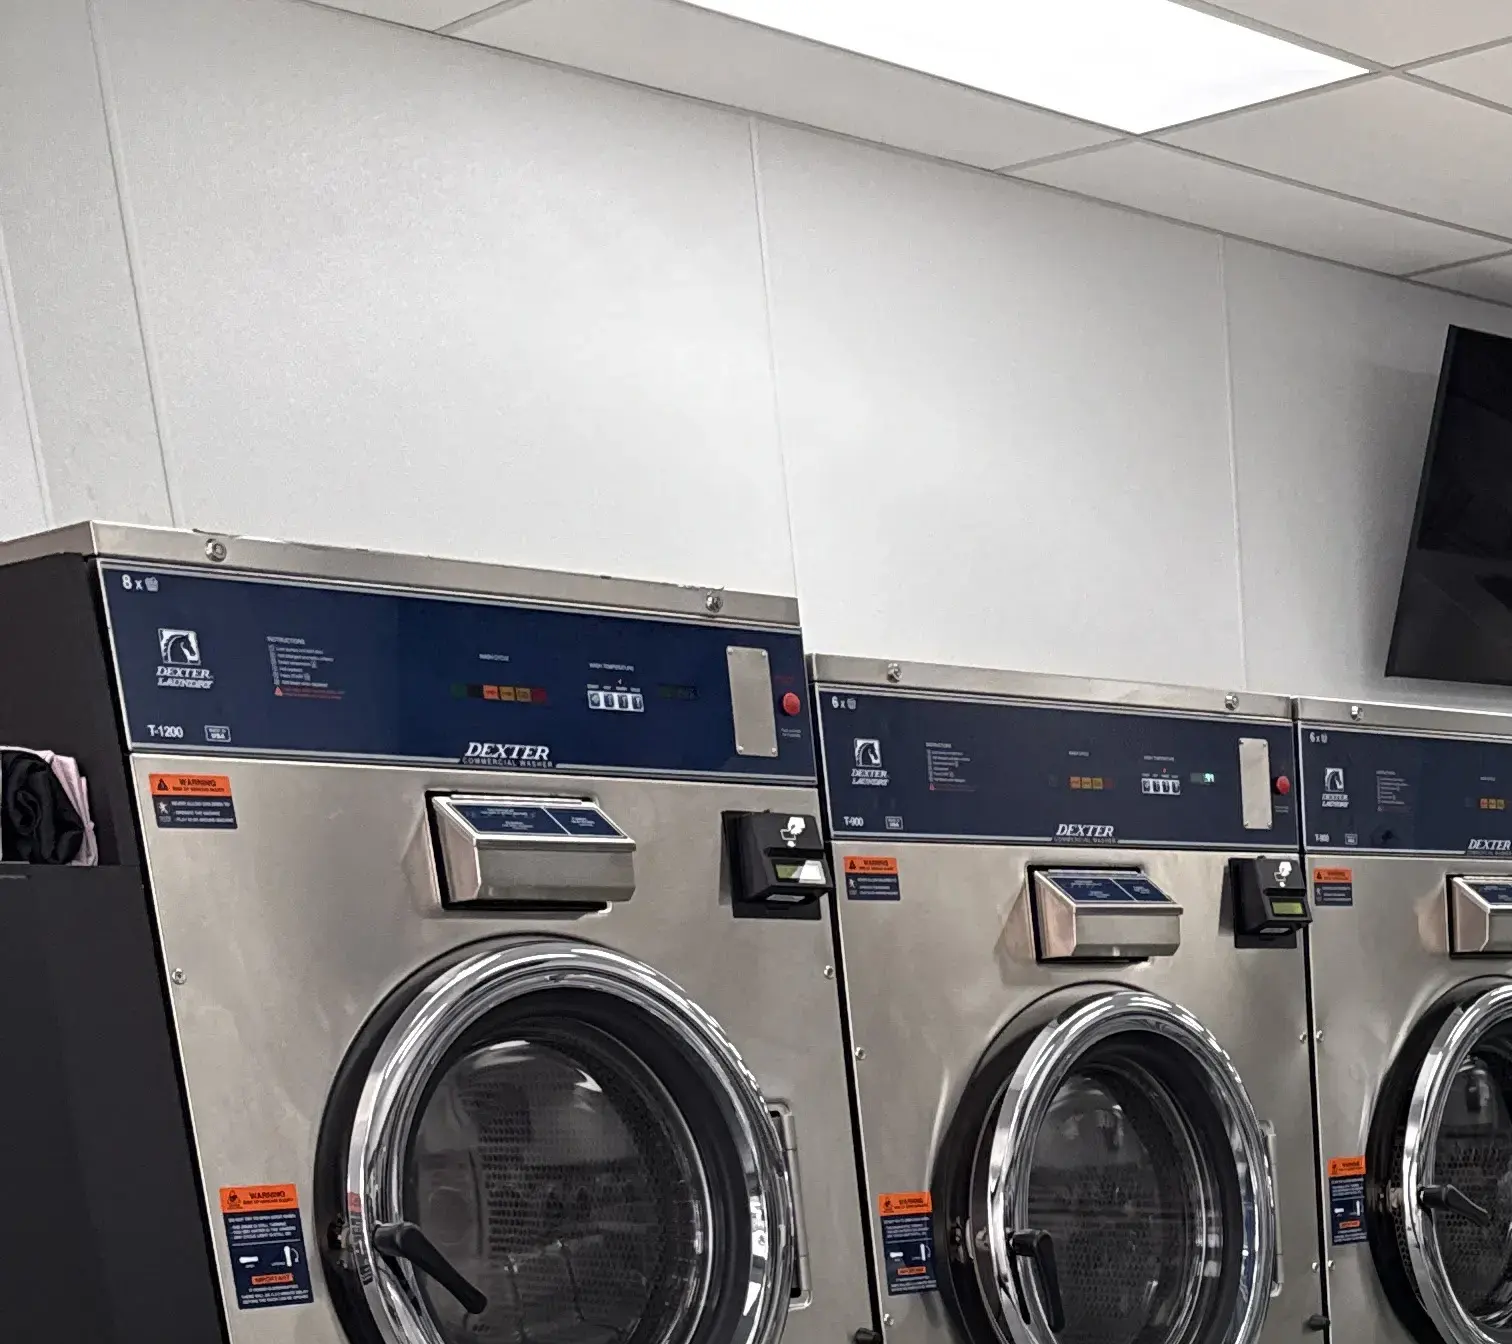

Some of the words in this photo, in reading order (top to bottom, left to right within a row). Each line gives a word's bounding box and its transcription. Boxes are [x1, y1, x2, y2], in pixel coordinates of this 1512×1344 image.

[121, 574, 133, 590] 8
[156, 666, 211, 679] DEXTER
[157, 678, 213, 689] LAUNDRY
[147, 724, 184, 738] T-1200
[464, 741, 550, 760] DEXTER
[461, 757, 517, 767] COMMERCIAL
[851, 768, 888, 778] DEXTER
[1056, 824, 1115, 837] DEXTER
[1467, 838, 1512, 851] DEXTER
[248, 1191, 286, 1199] WARNING
